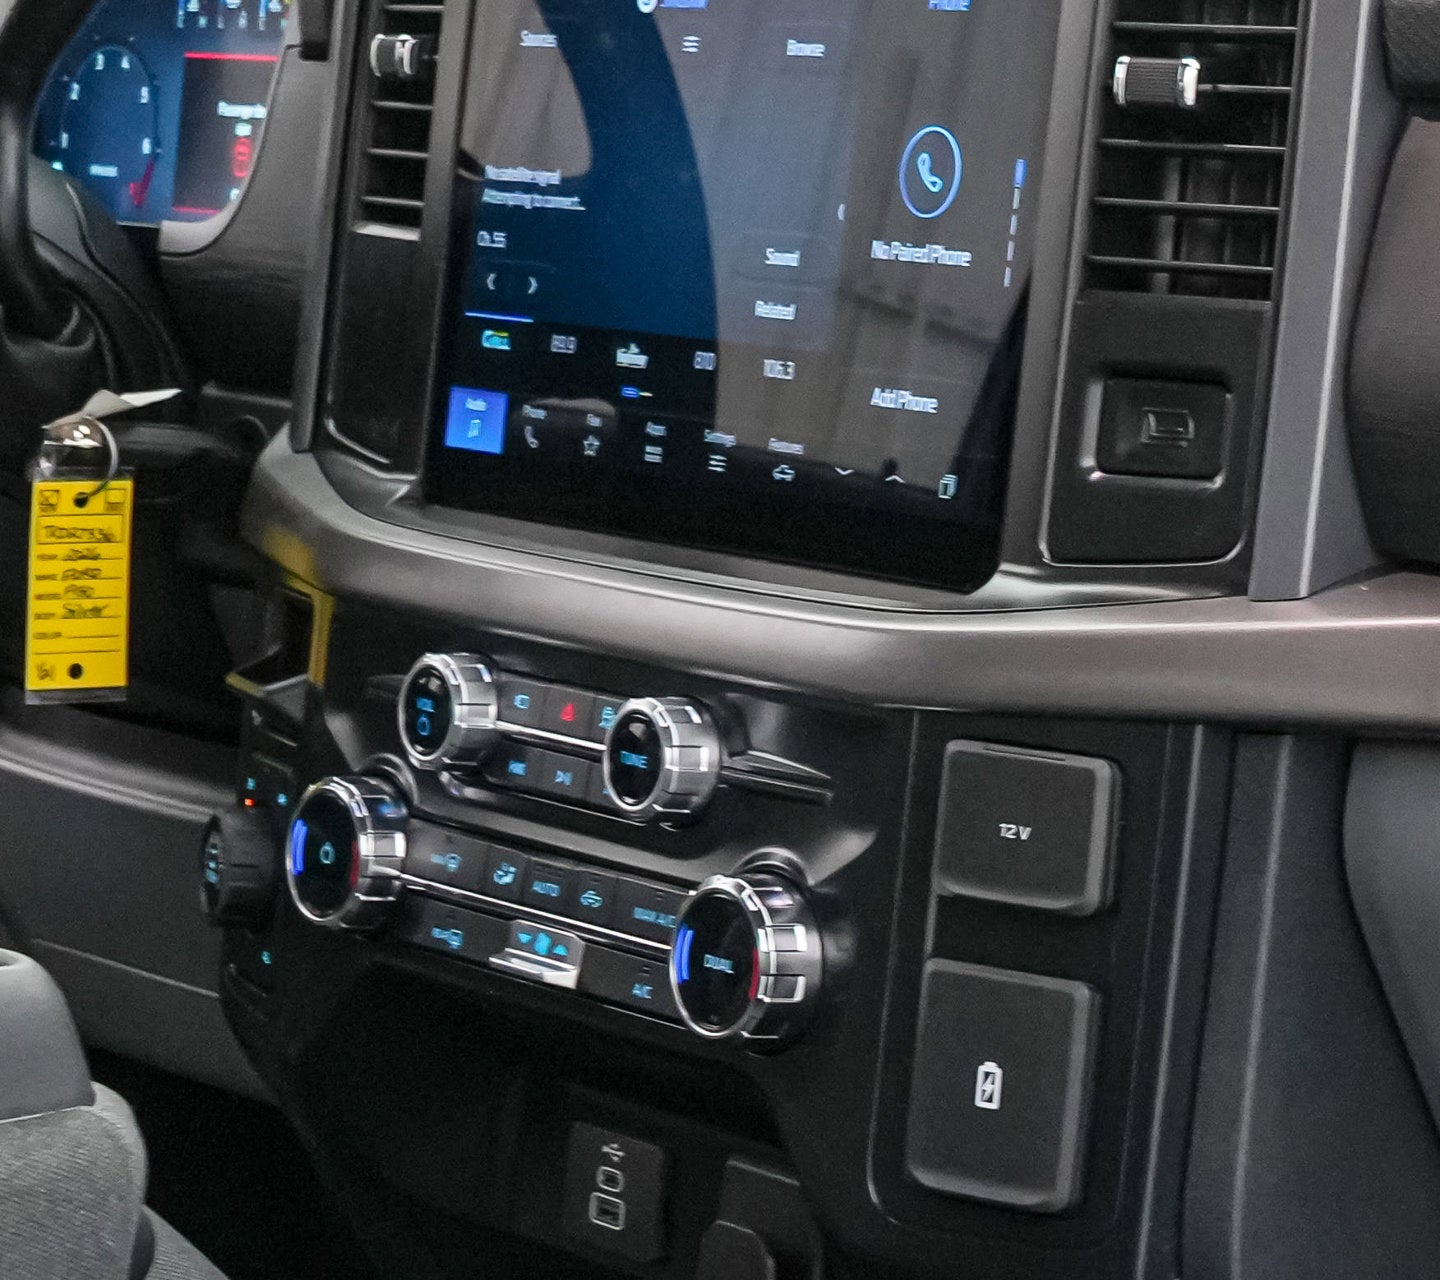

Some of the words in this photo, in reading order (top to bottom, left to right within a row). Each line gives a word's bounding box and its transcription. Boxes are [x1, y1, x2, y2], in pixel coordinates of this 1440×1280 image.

[871, 240, 891, 260] No
[891, 241, 926, 263] Paired
[927, 244, 972, 267] Phone
[870, 387, 898, 408] Add
[898, 390, 938, 413] Phone
[533, 882, 559, 896] AUTO
[704, 954, 734, 973] DUAL
